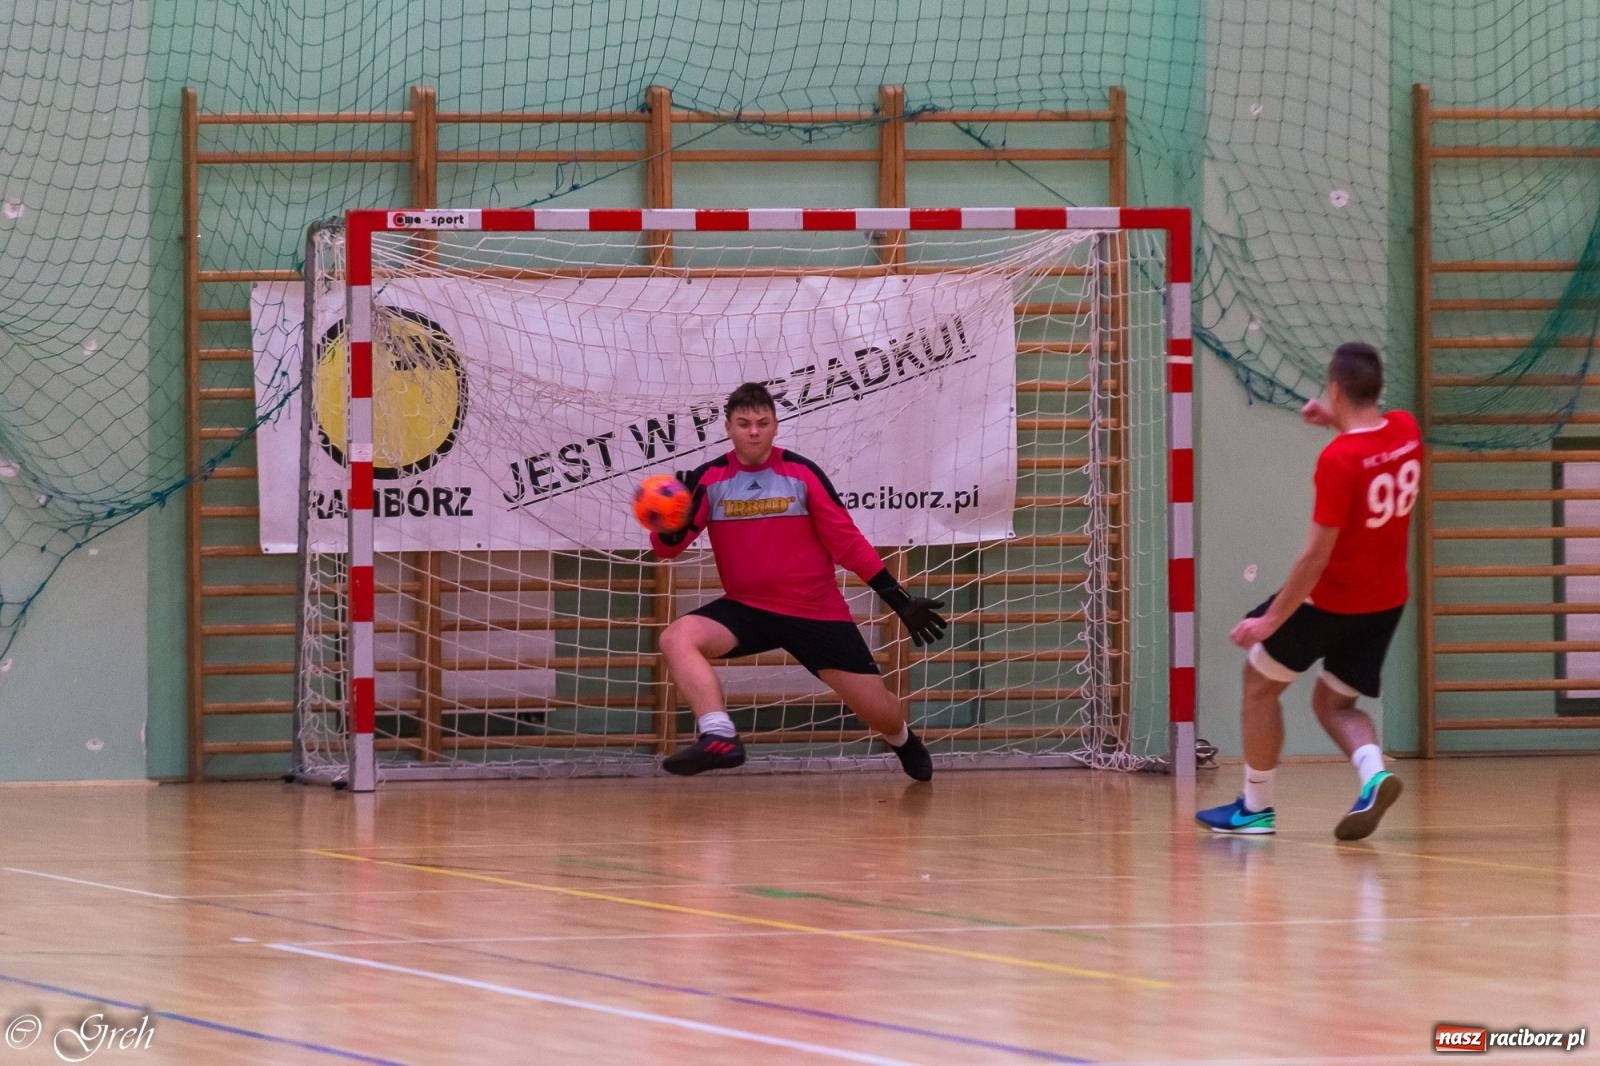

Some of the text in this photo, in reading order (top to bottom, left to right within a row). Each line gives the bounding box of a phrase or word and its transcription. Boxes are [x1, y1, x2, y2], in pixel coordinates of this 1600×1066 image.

[503, 313, 972, 504] JEST W PRZĄDKU!
[307, 480, 474, 519] RAIBÓRZ
[1365, 458, 1421, 529] 98
